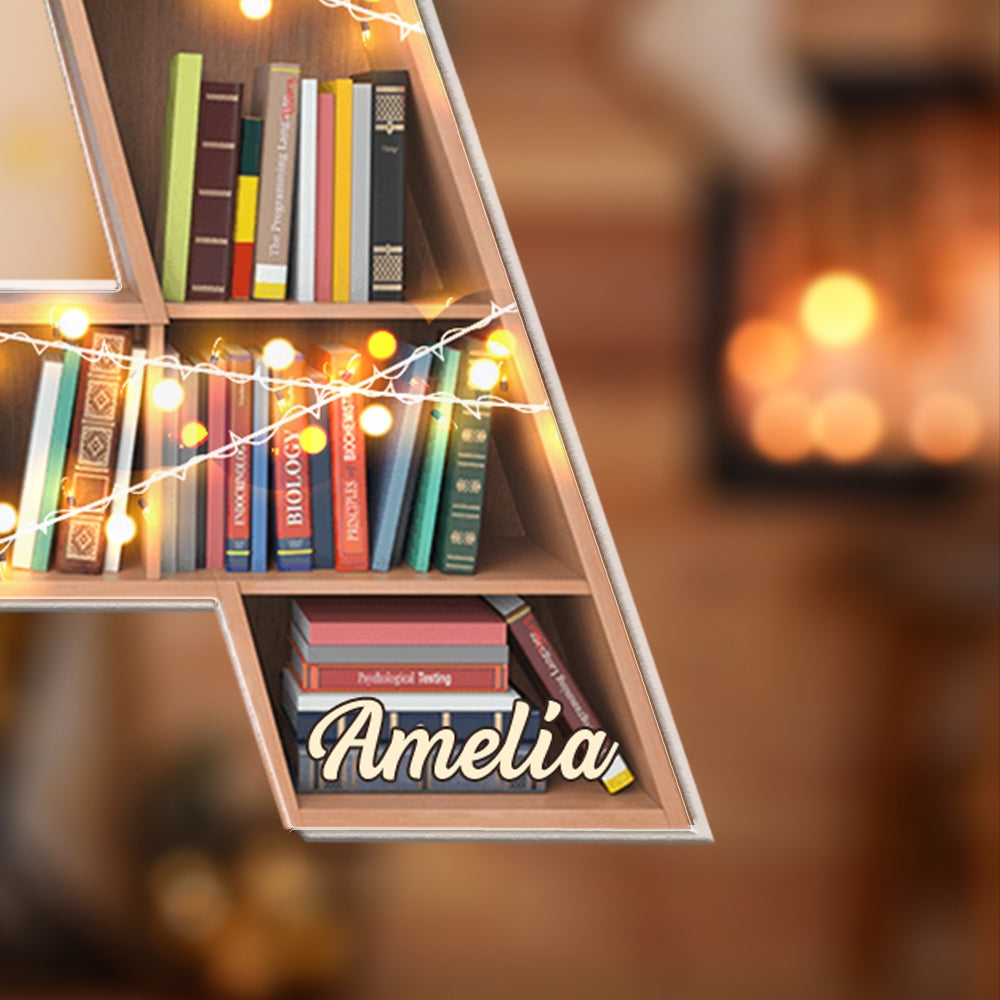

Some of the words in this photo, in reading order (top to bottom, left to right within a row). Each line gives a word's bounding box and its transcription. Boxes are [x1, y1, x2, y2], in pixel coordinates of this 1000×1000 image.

[234, 443, 249, 527] ENDOCRINOLOG
[284, 429, 303, 527] BIOLOGY
[417, 670, 452, 687] Testing
[308, 697, 620, 783] Amelia
